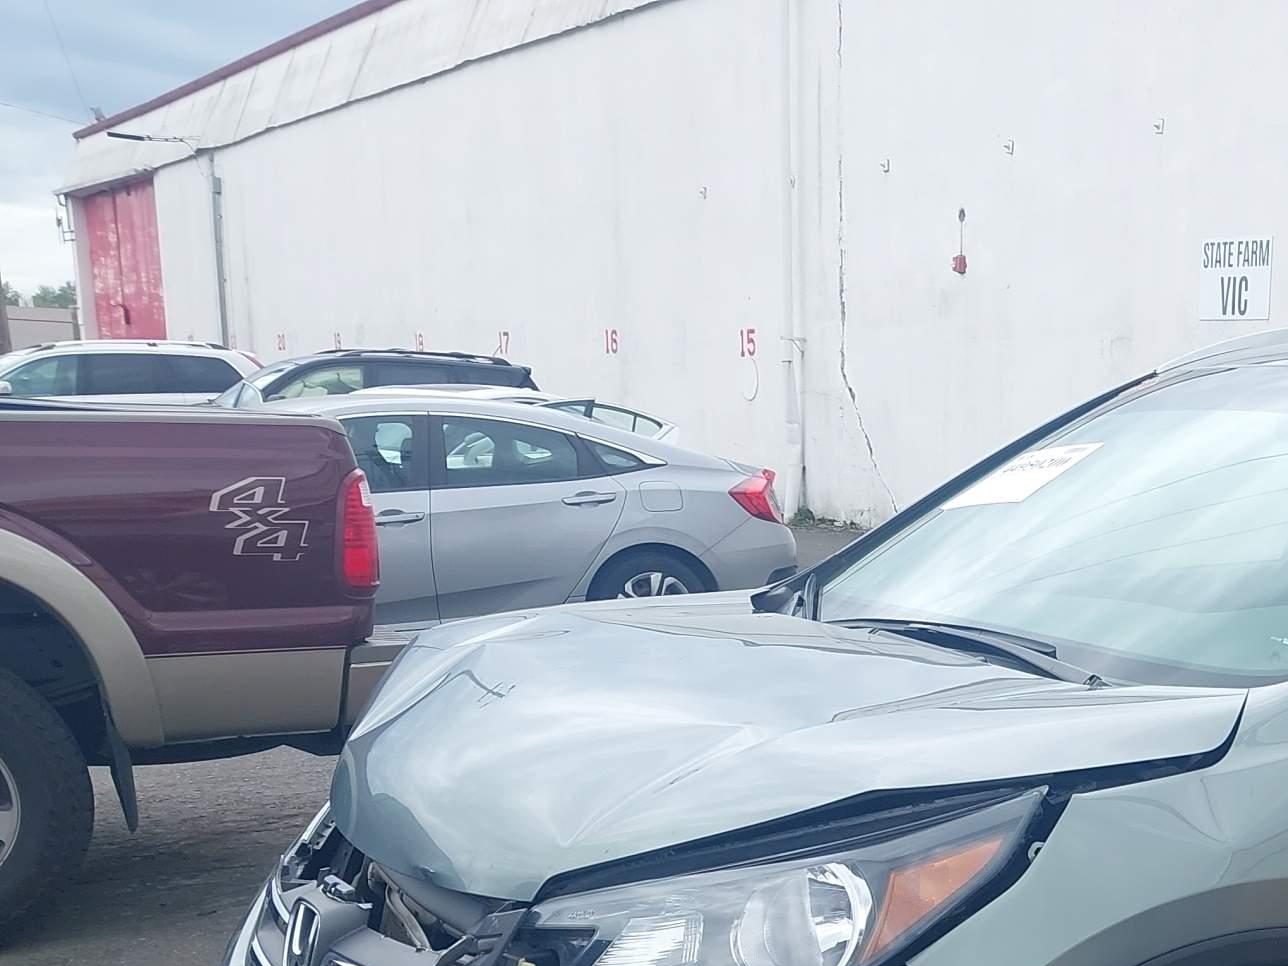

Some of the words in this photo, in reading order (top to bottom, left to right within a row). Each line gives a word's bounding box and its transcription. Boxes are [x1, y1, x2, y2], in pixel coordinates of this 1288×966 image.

[1203, 241, 1234, 268] STATE
[1237, 239, 1270, 267] FARM
[1220, 275, 1249, 316] VIC
[499, 331, 510, 354] 17
[605, 329, 618, 354] 16
[740, 329, 756, 357] 15
